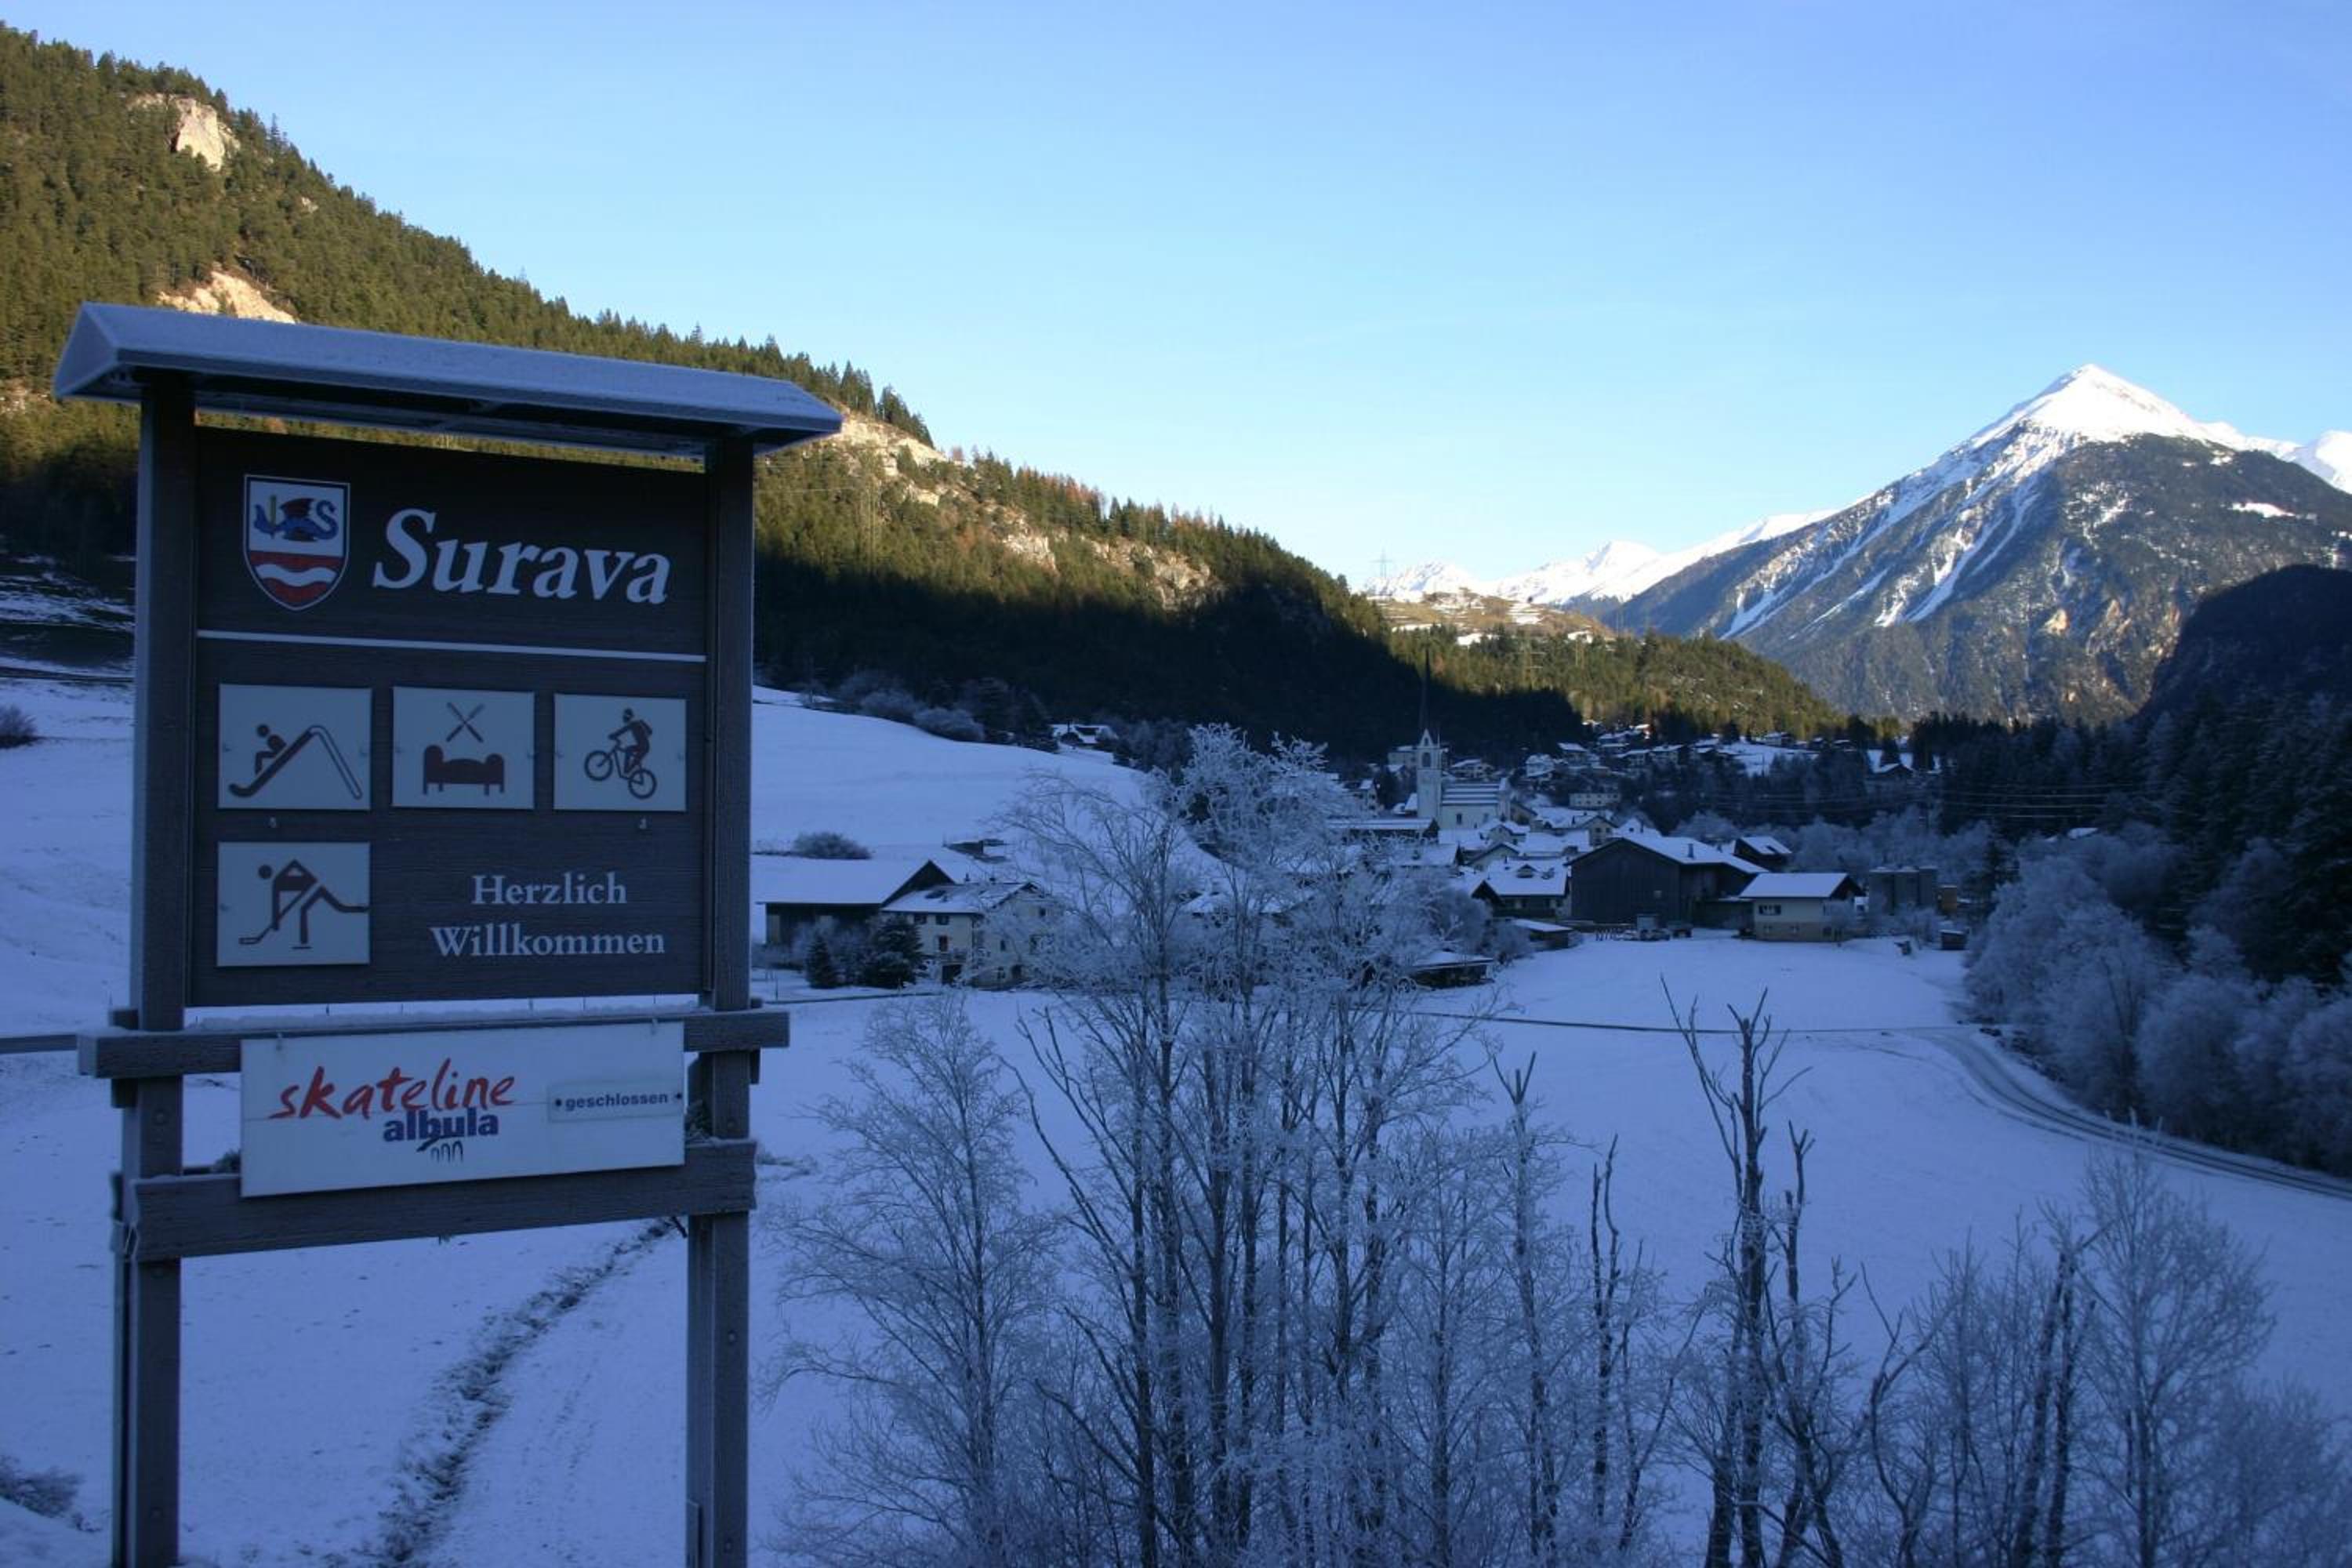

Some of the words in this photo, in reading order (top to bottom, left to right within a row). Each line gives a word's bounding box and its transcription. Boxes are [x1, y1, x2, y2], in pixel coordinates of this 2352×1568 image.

[372, 509, 671, 604] Surava
[471, 872, 628, 905] Herzlich
[430, 923, 665, 957] Willkommen
[268, 1058, 515, 1120] skateline
[564, 1091, 669, 1112] geschlossen
[383, 1106, 499, 1142] albula
